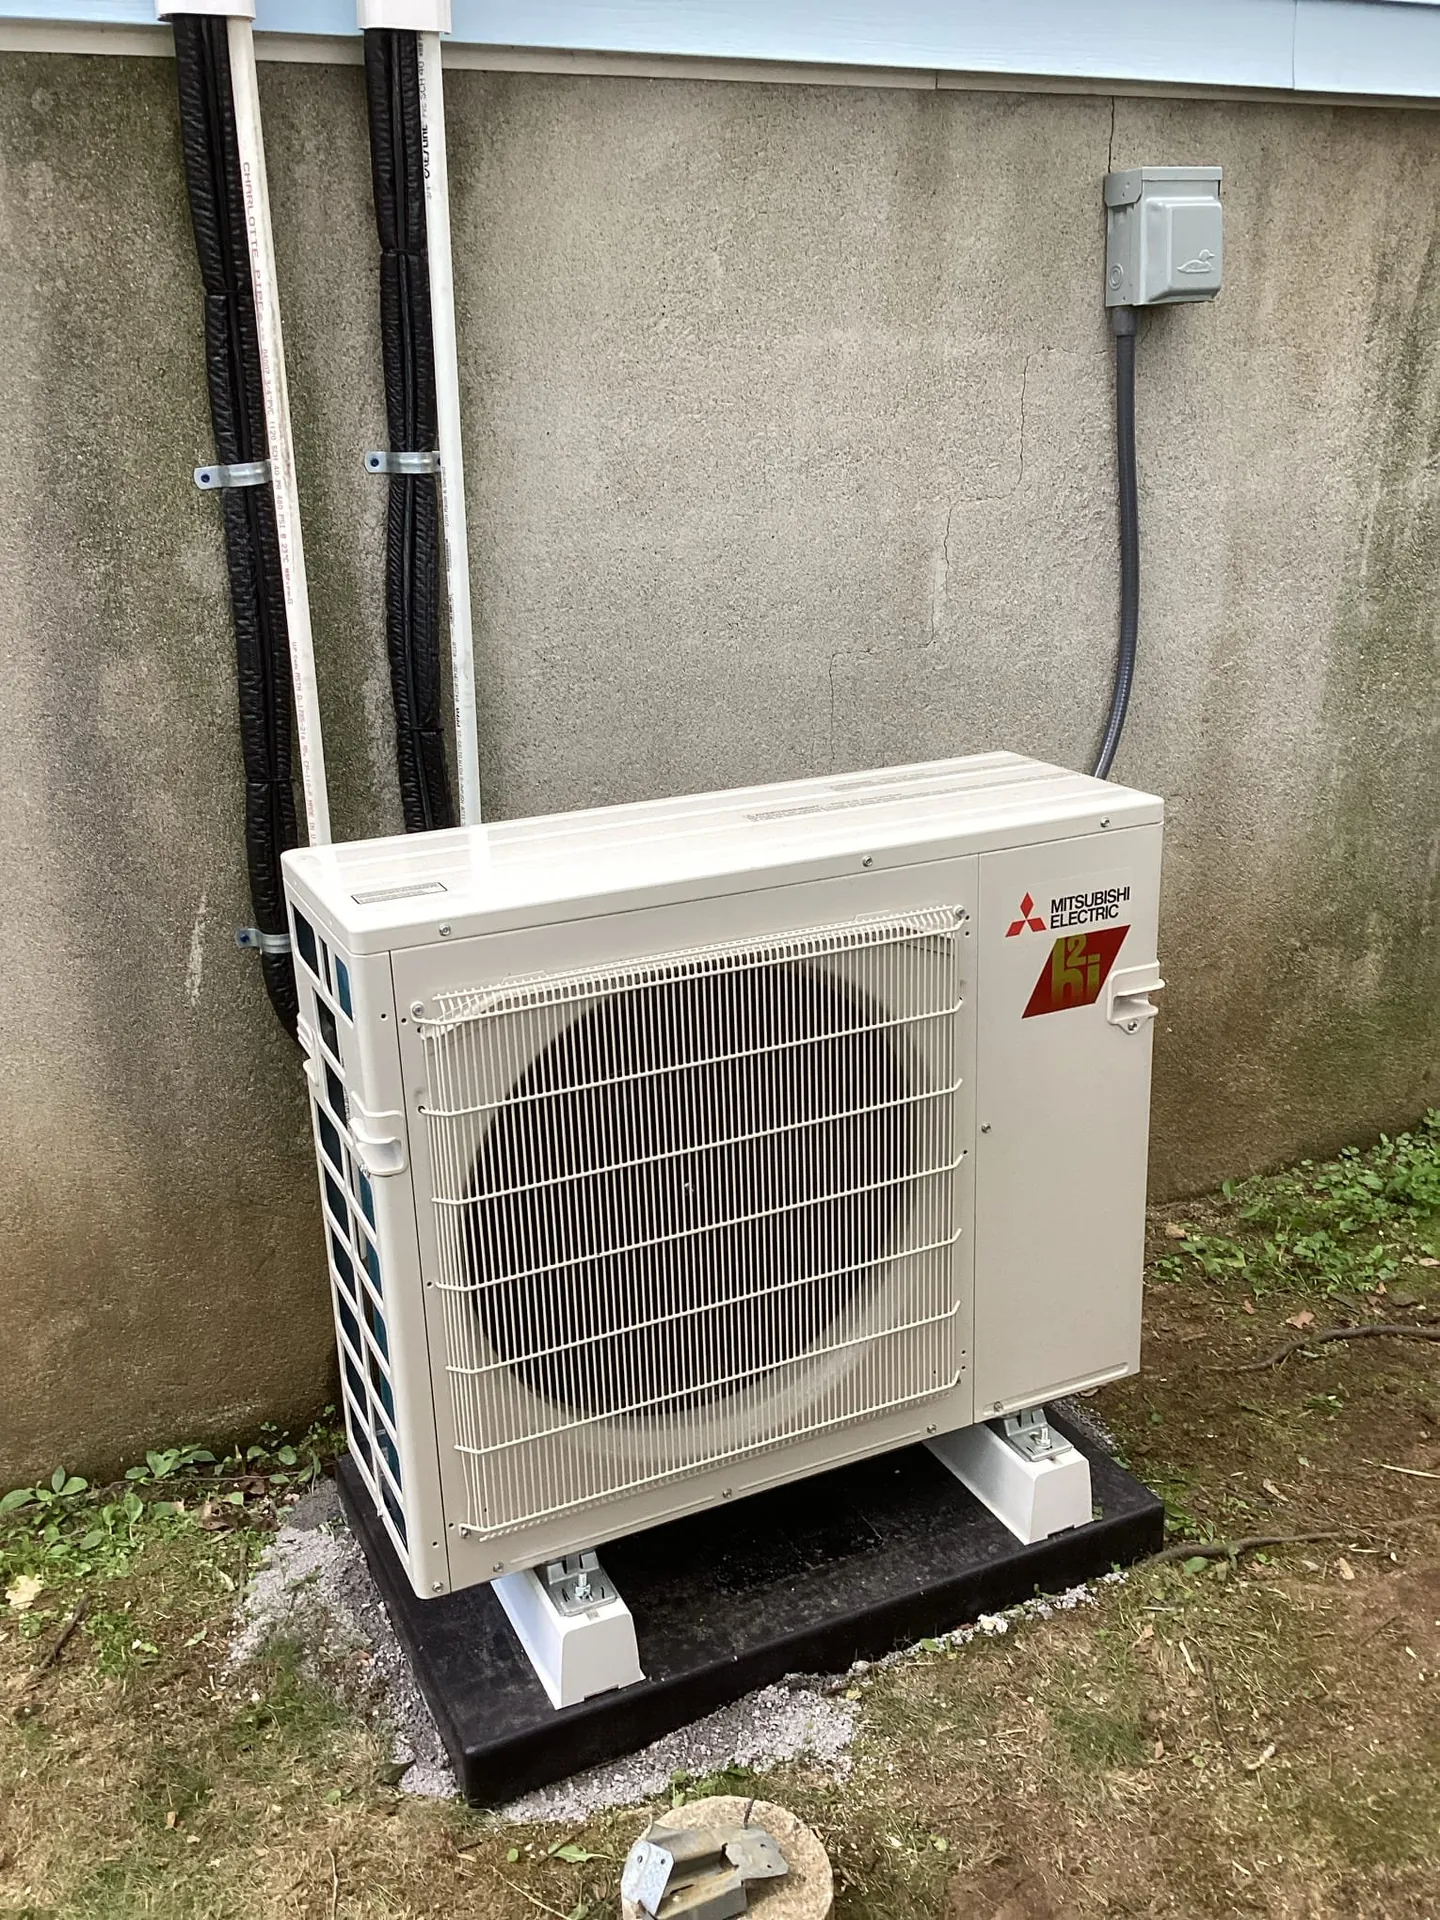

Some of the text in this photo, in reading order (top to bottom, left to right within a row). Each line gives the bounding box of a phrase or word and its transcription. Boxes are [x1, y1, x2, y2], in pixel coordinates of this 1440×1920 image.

[243, 162, 259, 257] CHARLOTTE
[255, 269, 264, 310] PIPE
[1050, 886, 1130, 914] MITSUBISHI
[1050, 904, 1119, 929] ELECTRIC
